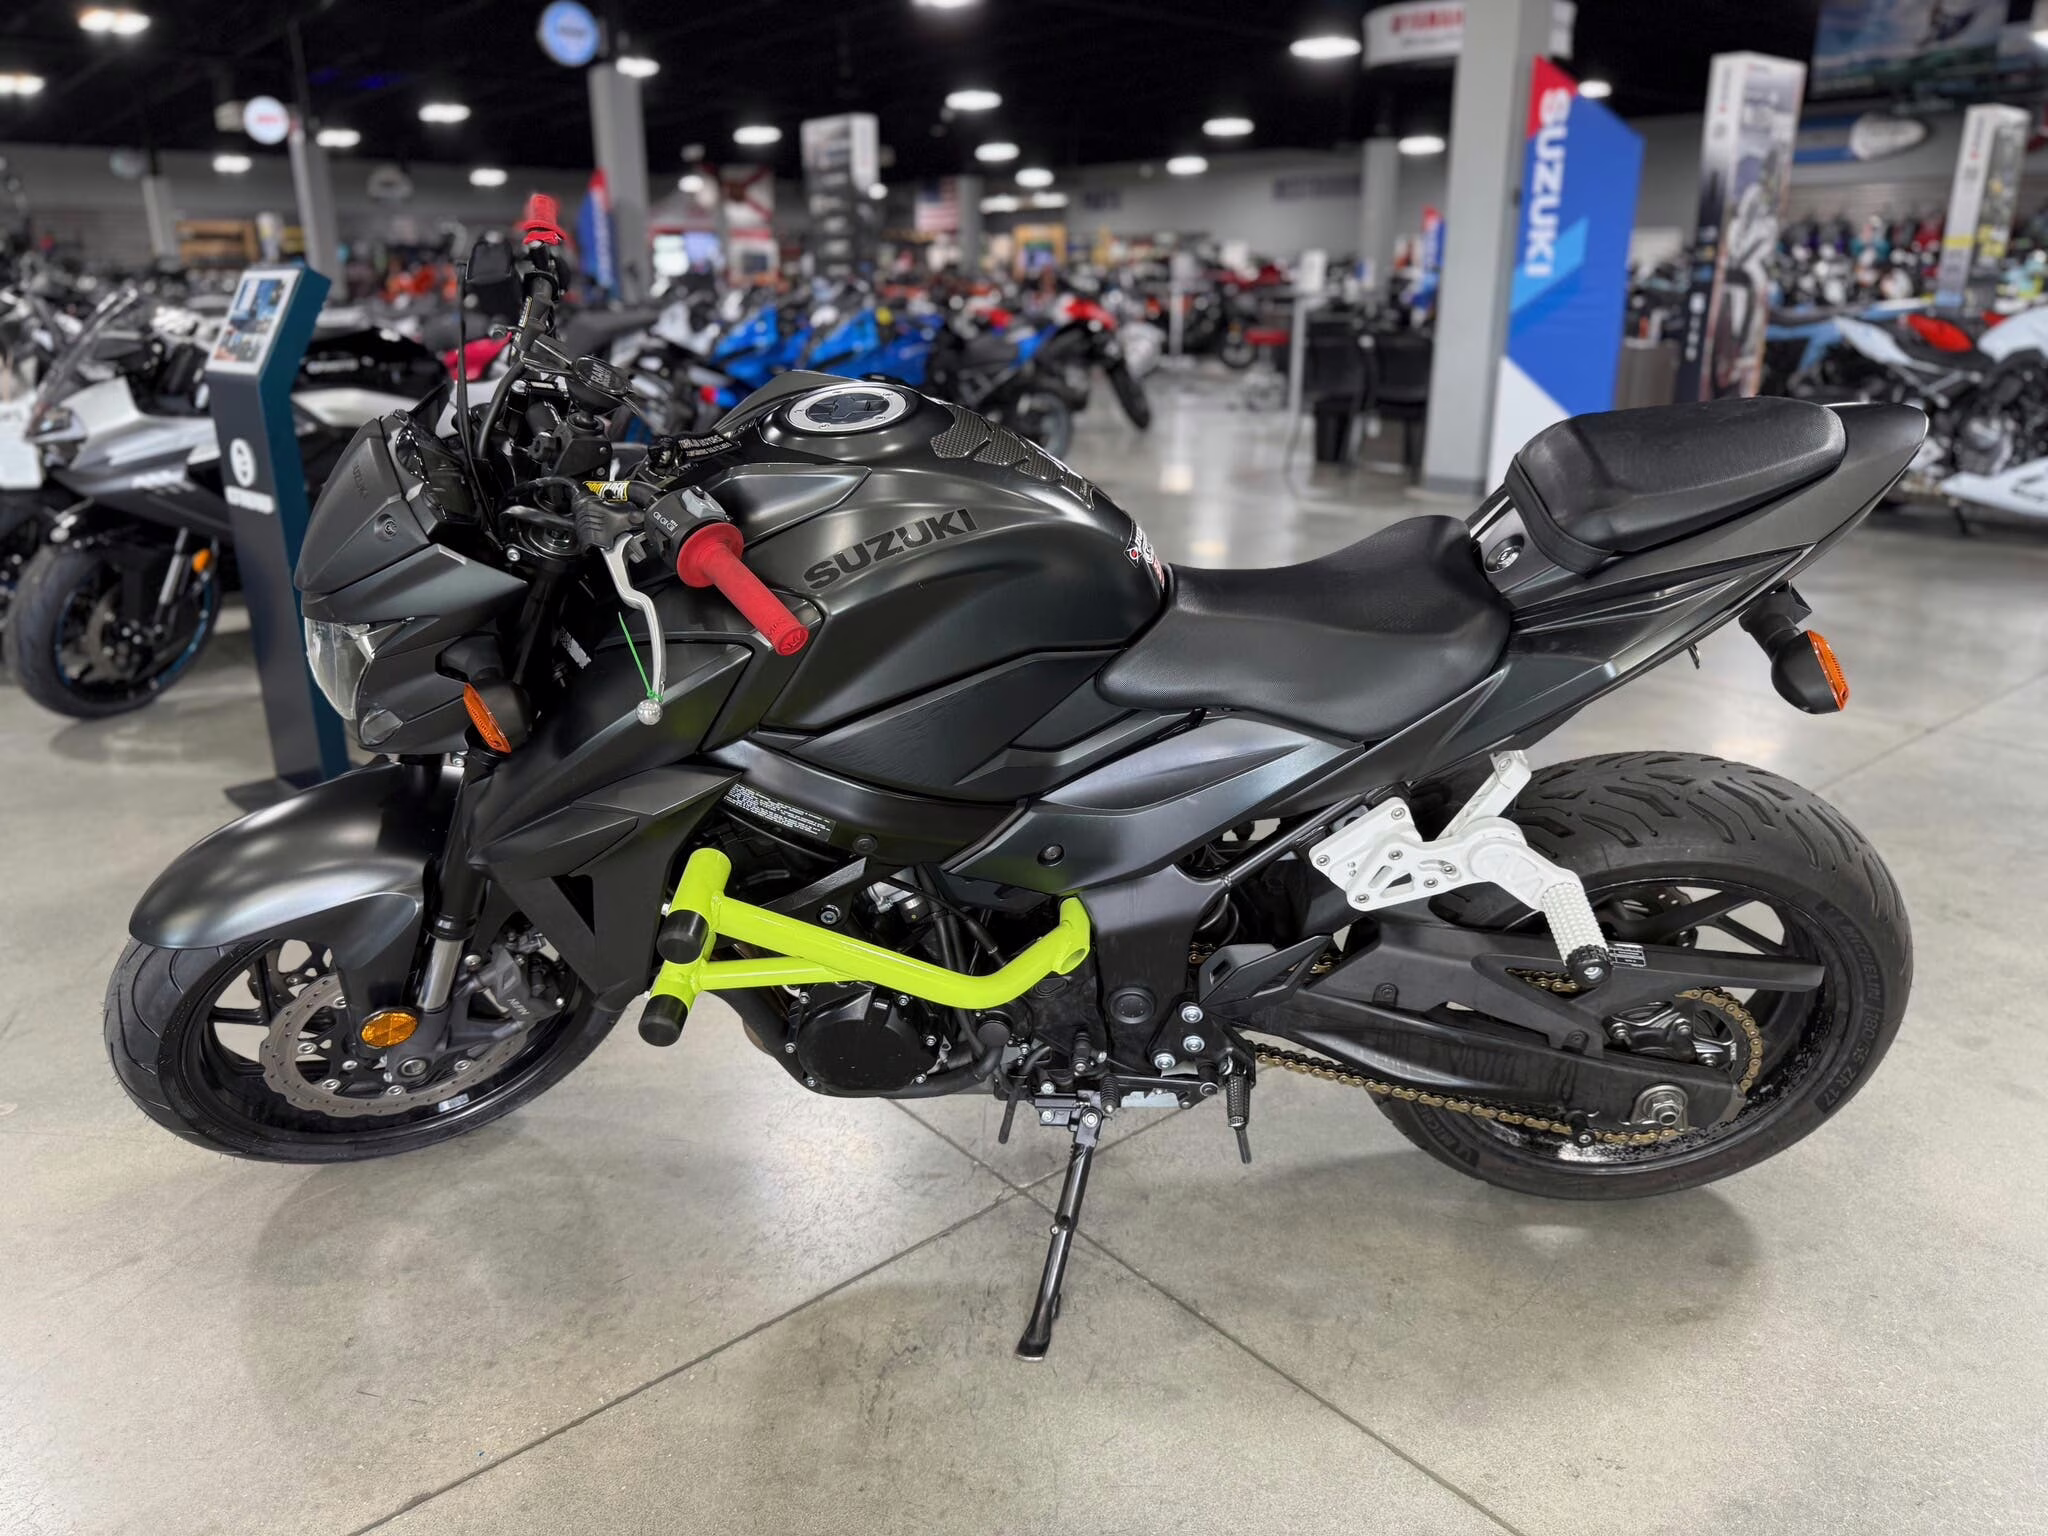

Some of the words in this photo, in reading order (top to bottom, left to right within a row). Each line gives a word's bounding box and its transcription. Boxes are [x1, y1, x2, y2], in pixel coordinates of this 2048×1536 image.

[1524, 88, 1571, 277] SUZUKI
[803, 508, 978, 590] SUZUKI
[1842, 923, 1882, 1001] MICHELIN
[1836, 1066, 1857, 1088] ZR
